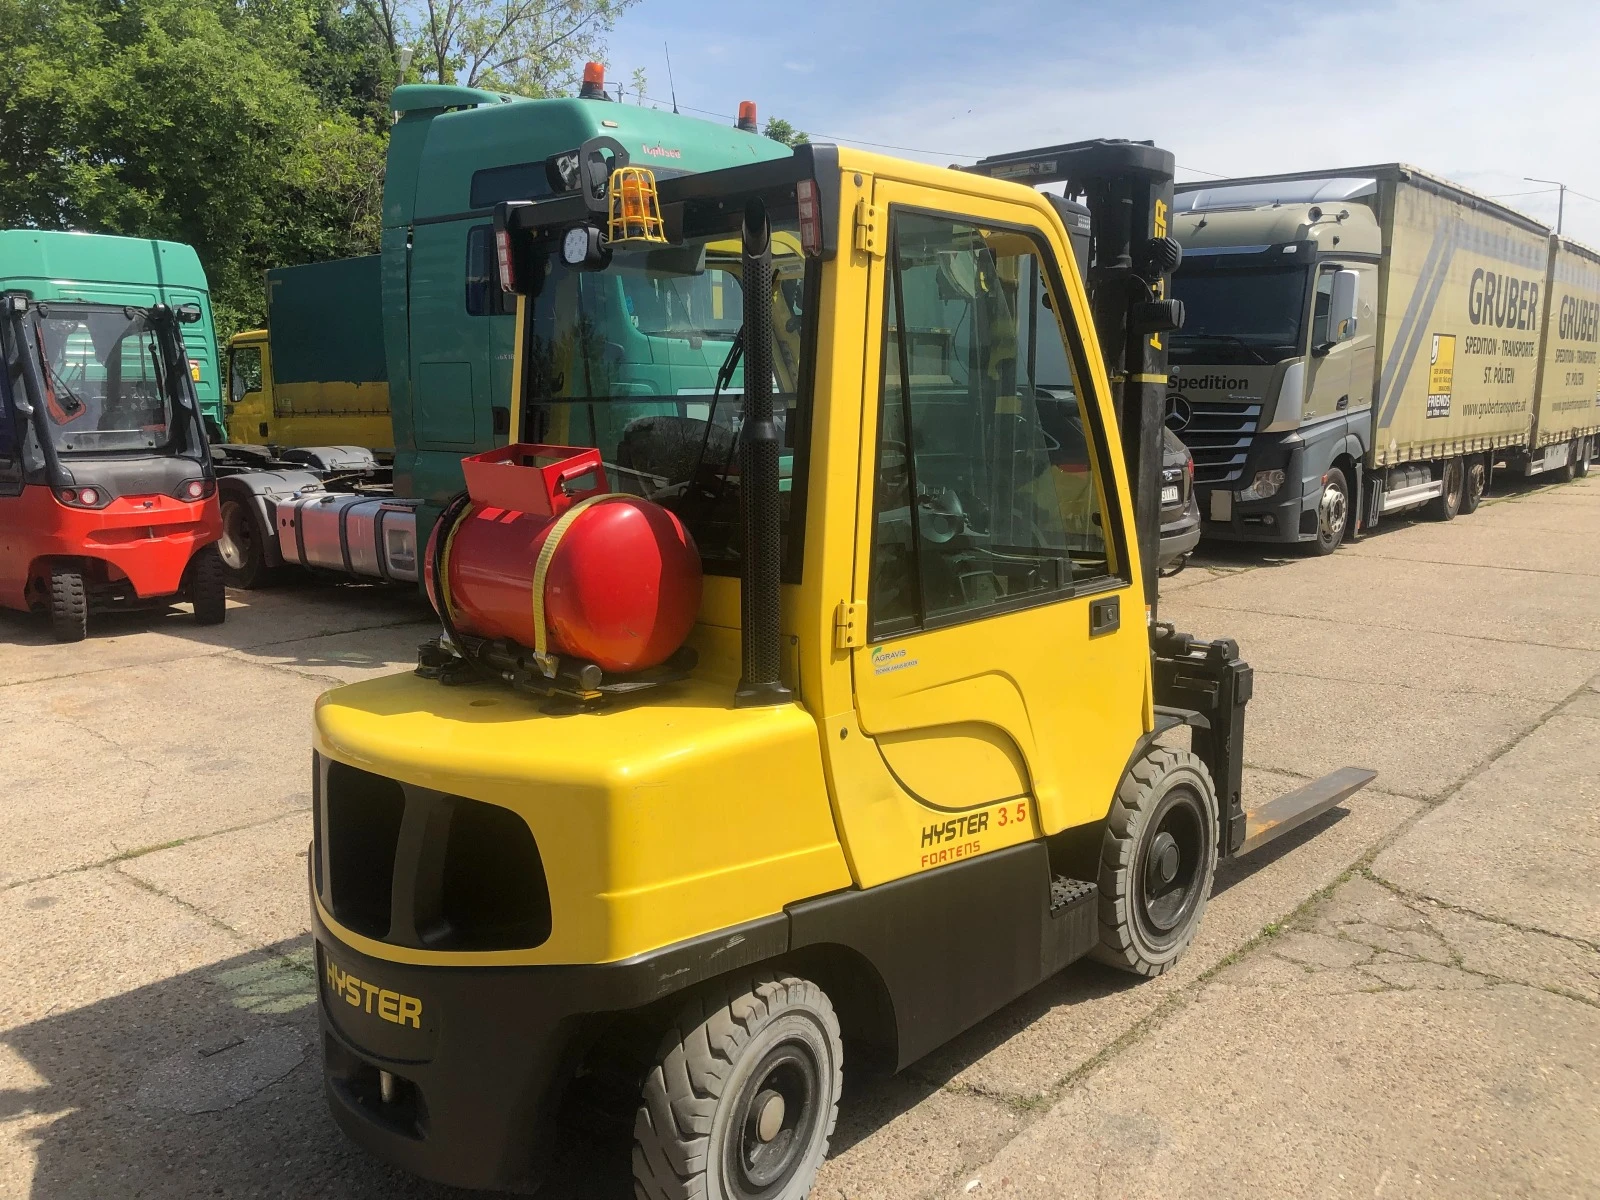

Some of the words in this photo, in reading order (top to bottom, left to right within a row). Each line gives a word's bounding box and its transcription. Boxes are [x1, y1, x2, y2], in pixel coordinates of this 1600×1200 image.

[1469, 268, 1538, 330] GRUBER
[1559, 295, 1599, 342] GRUBER
[1465, 336, 1497, 355] SPEDITION
[1502, 340, 1535, 357] TRANSPORTE
[1167, 375, 1249, 392] Spedition
[1484, 366, 1492, 384] ST.
[1494, 362, 1515, 384] PÖLTEN
[1427, 395, 1451, 408] FRIENDS
[1440, 408, 1450, 416] road
[1463, 398, 1527, 419] www.grubertransporte.at
[875, 650, 906, 663] AGRAVIS
[921, 812, 988, 848] HYSTER
[998, 803, 1026, 826] 3.5
[921, 841, 981, 868] FORTENS
[326, 955, 422, 1029] HYSTER
